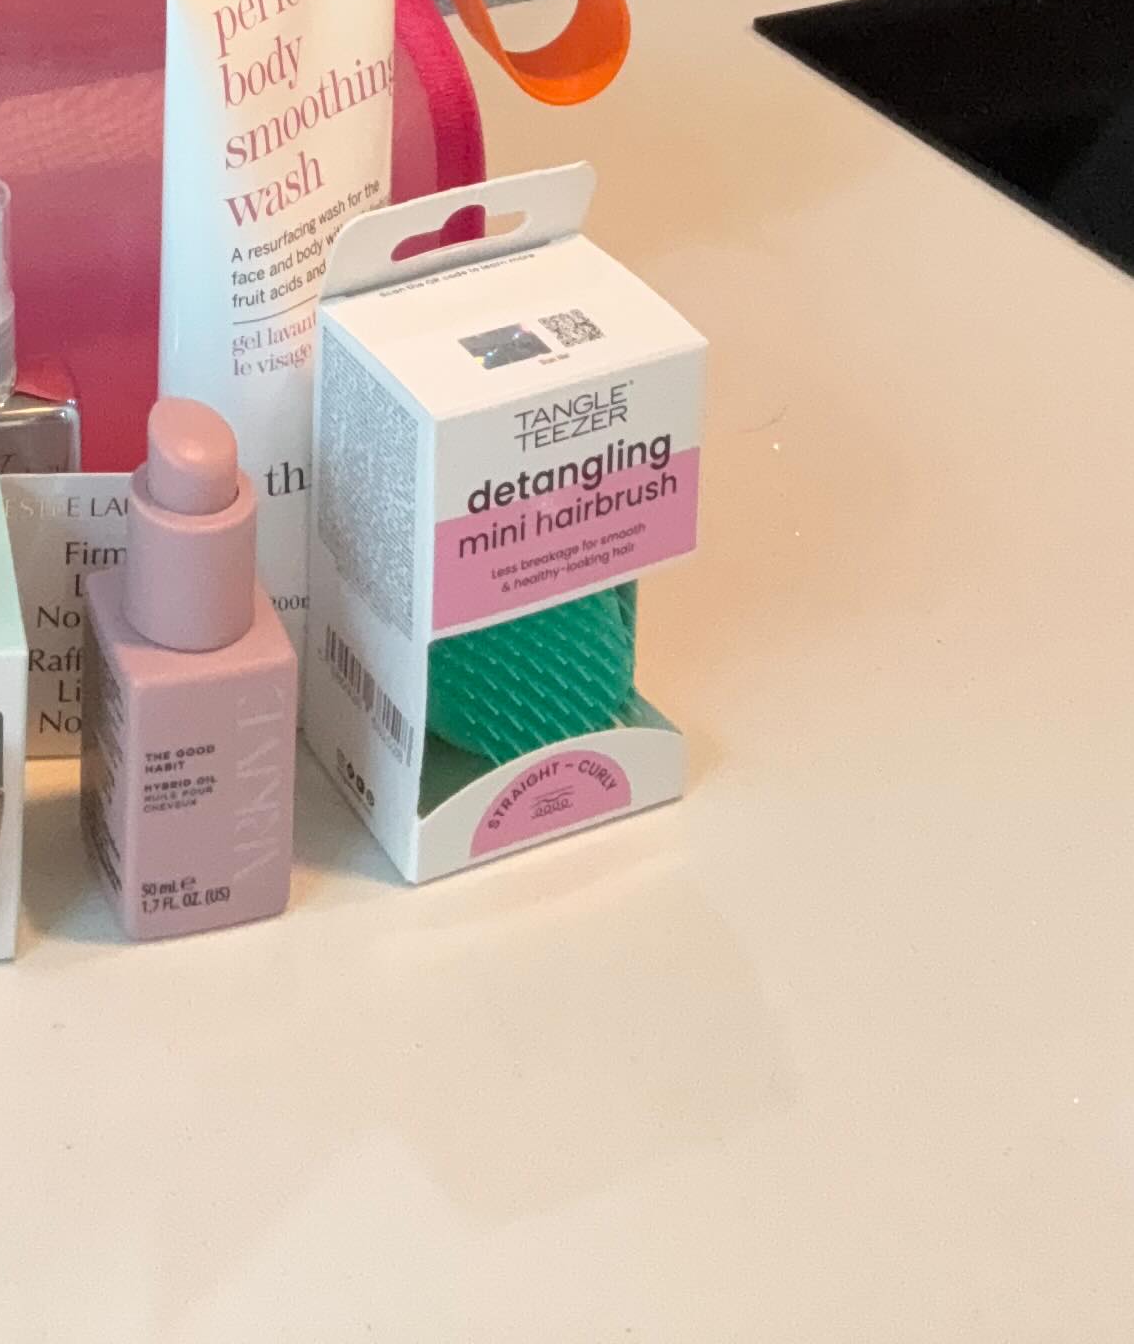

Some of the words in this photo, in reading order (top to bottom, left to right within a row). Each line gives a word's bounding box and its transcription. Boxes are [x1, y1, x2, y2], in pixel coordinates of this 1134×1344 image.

[218, 34, 303, 109] body
[224, 150, 325, 228] wash
[231, 247, 243, 264] A
[247, 214, 317, 262] resurfacing
[318, 201, 346, 228] wash
[347, 189, 363, 214] for
[364, 179, 381, 202] the
[231, 264, 266, 288] face
[268, 256, 293, 278] and
[296, 235, 324, 266] body
[231, 288, 267, 310] fruit
[269, 276, 304, 303] acids
[306, 258, 327, 282] and
[378, 287, 406, 299] Scan
[407, 280, 426, 291] the
[442, 269, 468, 281] code
[231, 328, 263, 357] gel
[232, 358, 253, 377] le
[257, 341, 313, 374] visage
[513, 383, 629, 432] TANGLE
[514, 405, 629, 453] TEEZER
[467, 432, 673, 515] detangling
[457, 512, 533, 559] mini
[535, 471, 678, 538] hairbrush
[490, 564, 519, 580] Less
[520, 544, 580, 571] breakage
[581, 538, 599, 552] for
[600, 522, 647, 546] smooth
[500, 582, 511, 593] &
[513, 548, 610, 590] healthy-looking
[612, 542, 636, 558] hair
[36, 605, 81, 630] No
[39, 710, 82, 735] No
[145, 751, 171, 762] THE
[175, 744, 216, 759] GOOD
[145, 760, 186, 774] HABIT
[143, 777, 192, 793] HYBRID
[196, 775, 218, 786] OIL
[181, 785, 214, 797] POUR
[486, 760, 560, 831] STRAIGHT
[576, 758, 620, 793] CURLY
[143, 798, 198, 814] CHEVEUX
[141, 882, 157, 899] 50
[142, 898, 160, 914] 1.7
[205, 885, 231, 906] (US)
